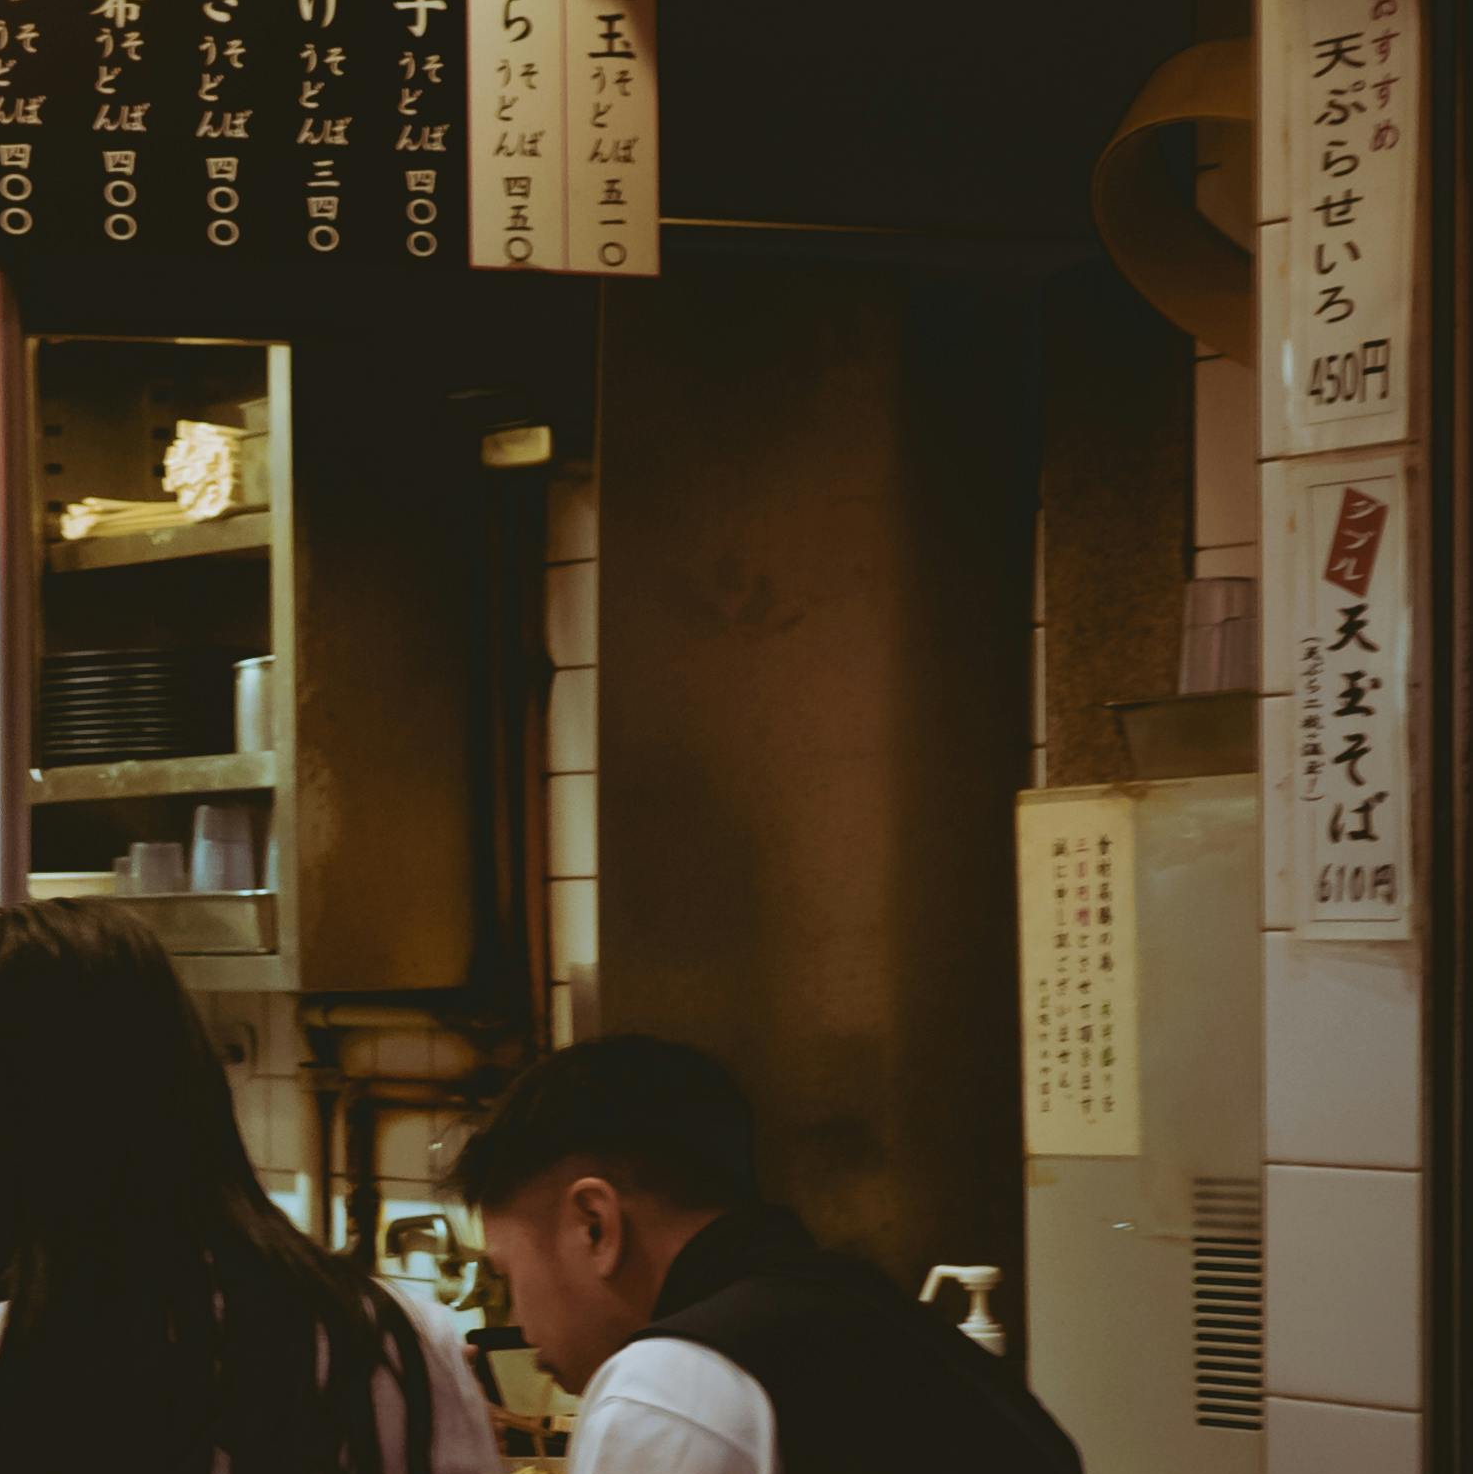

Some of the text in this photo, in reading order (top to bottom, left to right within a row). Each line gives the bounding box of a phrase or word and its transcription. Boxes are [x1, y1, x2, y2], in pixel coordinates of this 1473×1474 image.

[1306, 32, 1391, 406] 天ぷらせいろ 450円
[1327, 604, 1389, 844] 天玉そば
